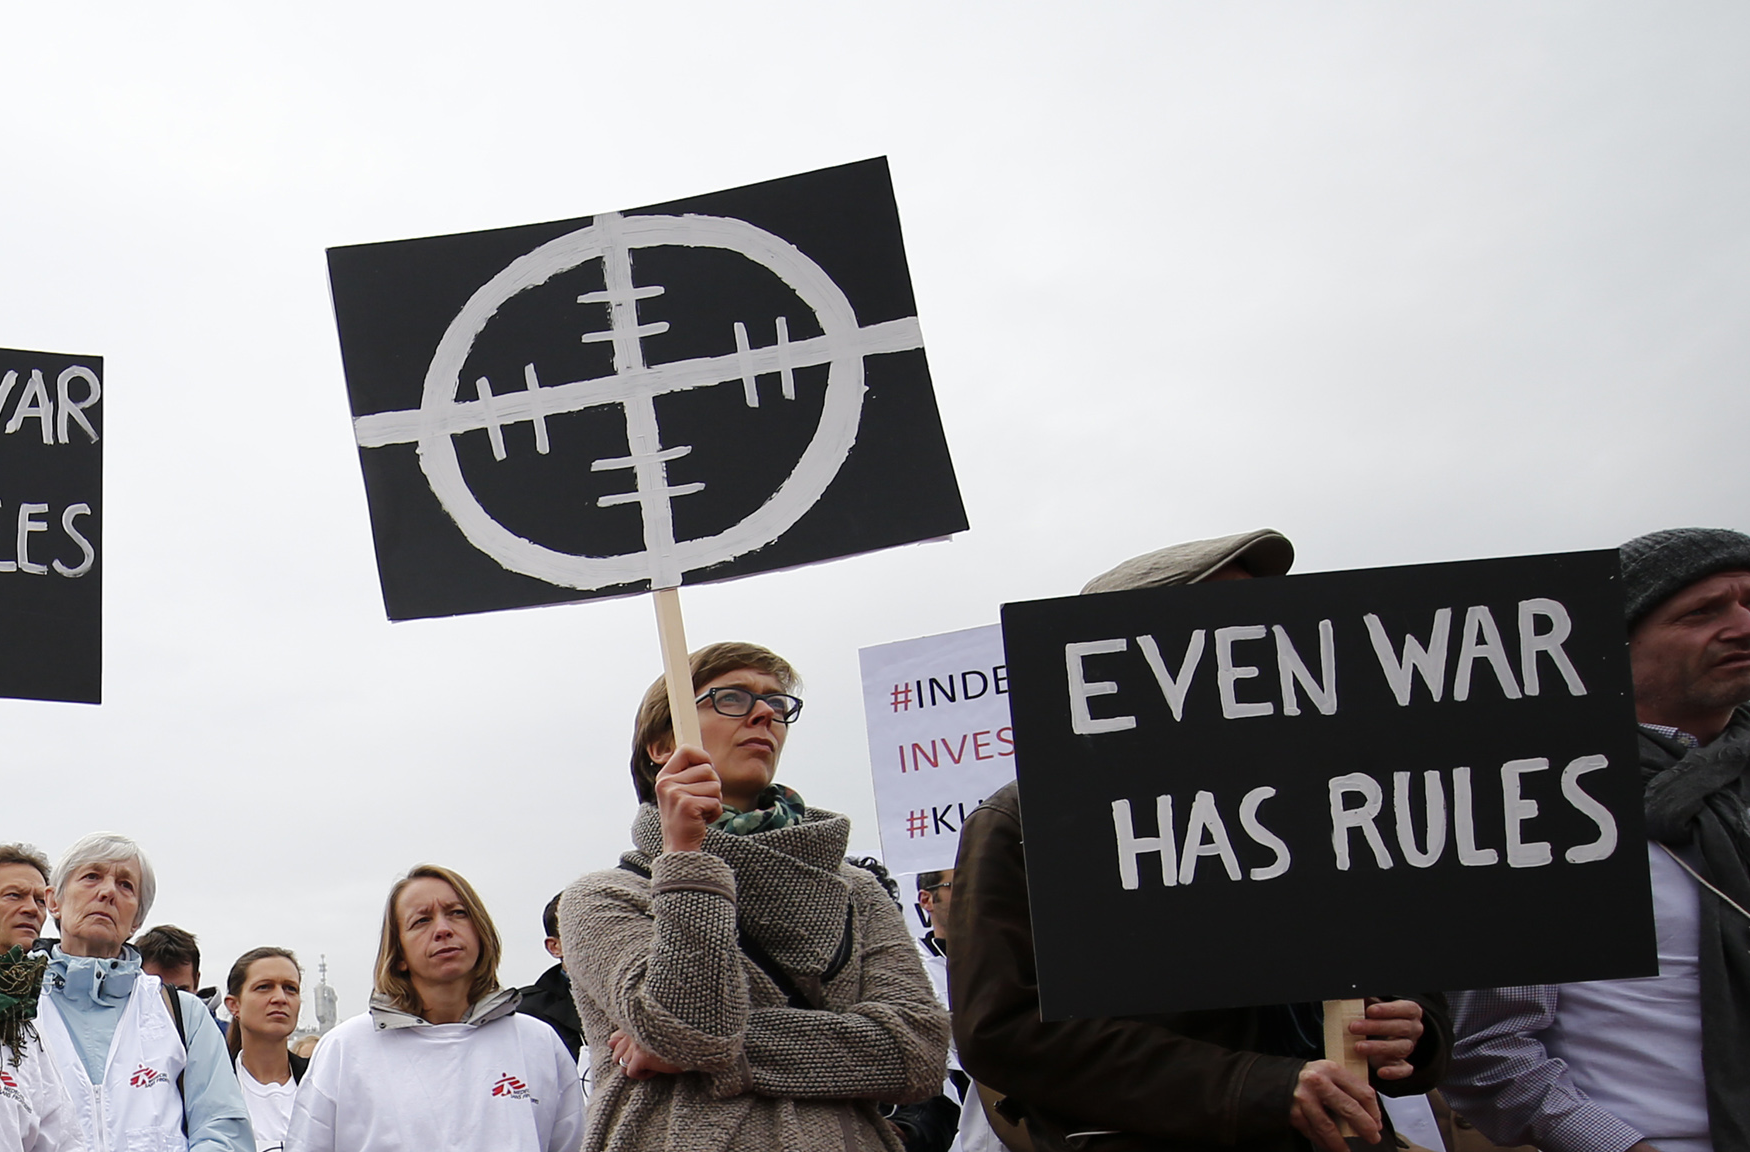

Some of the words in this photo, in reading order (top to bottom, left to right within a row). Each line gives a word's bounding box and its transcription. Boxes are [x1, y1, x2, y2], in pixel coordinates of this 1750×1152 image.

[1065, 619, 1337, 735] EVEN
[1364, 598, 1587, 707] WAR
[1111, 787, 1292, 890] HAS
[1329, 754, 1618, 870] RULES
